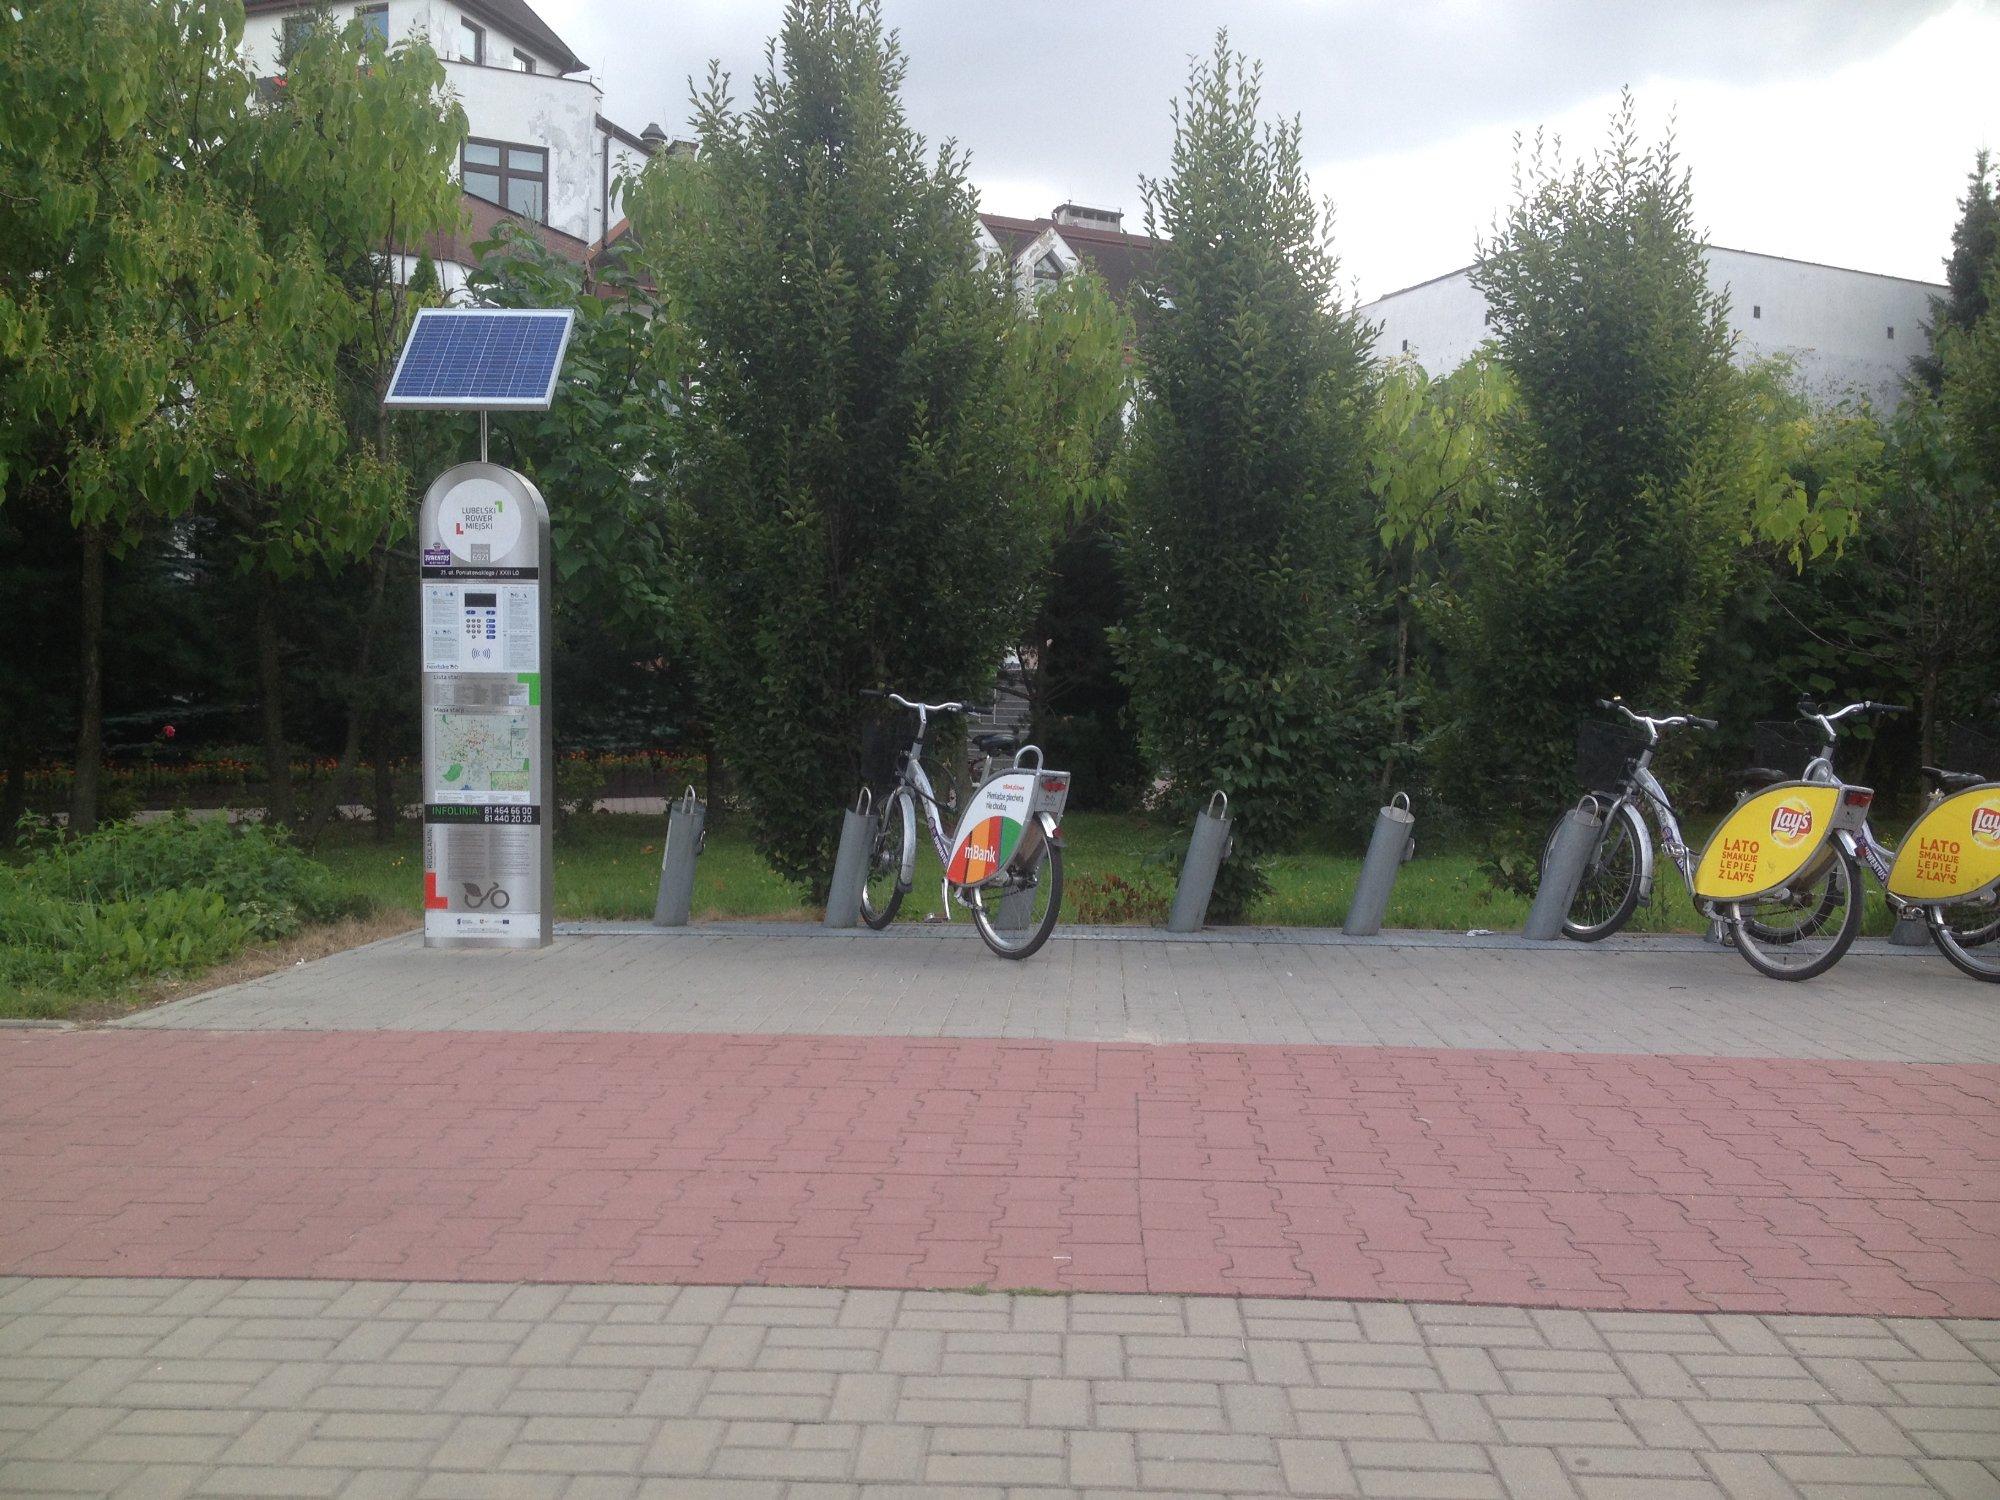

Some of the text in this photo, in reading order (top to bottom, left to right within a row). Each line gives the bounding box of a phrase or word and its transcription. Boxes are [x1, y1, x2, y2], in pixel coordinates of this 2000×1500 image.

[465, 522, 493, 531] MIEJSKI
[484, 806, 493, 815] 81
[494, 806, 509, 815] 464
[510, 806, 520, 815] 66
[521, 806, 532, 815] 00
[484, 814, 532, 823] 81 440 20 20
[1772, 807, 1811, 838] Lay's
[1973, 809, 2000, 841] Lay
[1723, 837, 1760, 854] LATO
[1920, 837, 1960, 855] LATO
[964, 845, 996, 863] mBank
[1721, 851, 1758, 863] SMAKUJE
[1919, 850, 1960, 864] SMAKUJE
[1720, 860, 1757, 872] LEPIEJ
[1917, 859, 1959, 873] LEPIEJ
[1718, 869, 1755, 883] Z LAY'S
[1916, 869, 1957, 885] Z LAY'S
